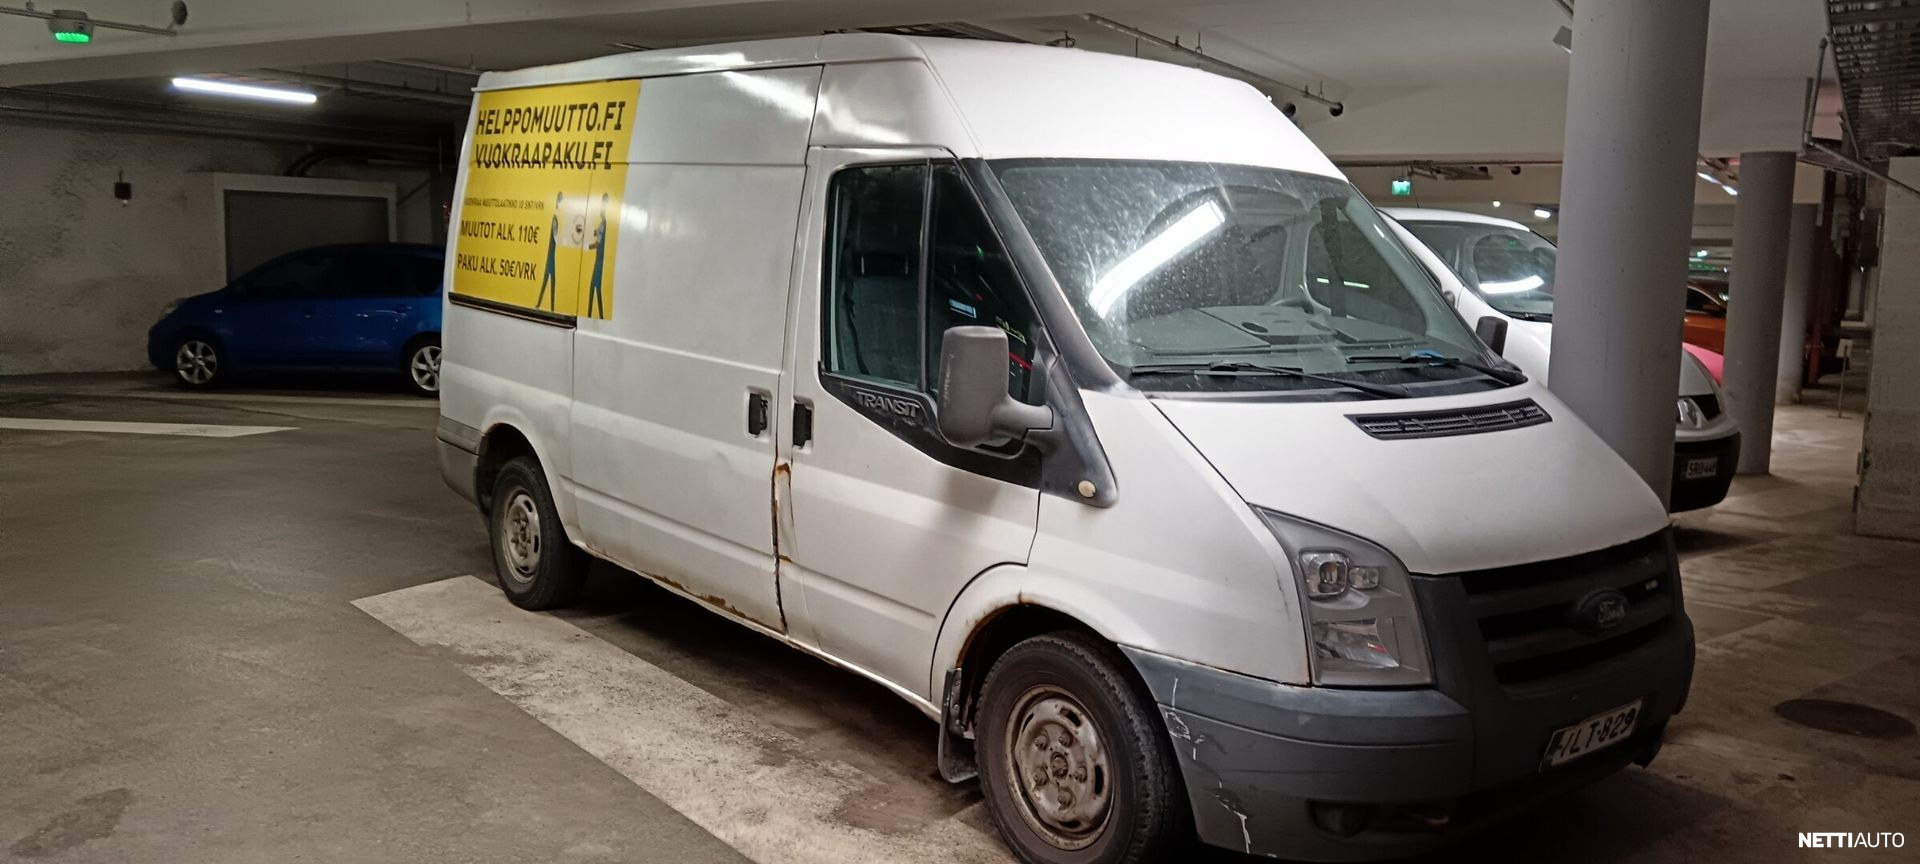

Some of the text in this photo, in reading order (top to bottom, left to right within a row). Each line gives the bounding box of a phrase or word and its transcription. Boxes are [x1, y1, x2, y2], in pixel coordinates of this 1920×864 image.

[475, 101, 626, 135] HELPPOMUUTTO.FI
[475, 141, 613, 170] VUOKRAAPAKU.FI
[461, 220, 540, 244] MUUTOT ALK. 110€
[457, 253, 537, 281] PAKU ALK. 50€/VRK
[856, 391, 921, 418] TRANSIT
